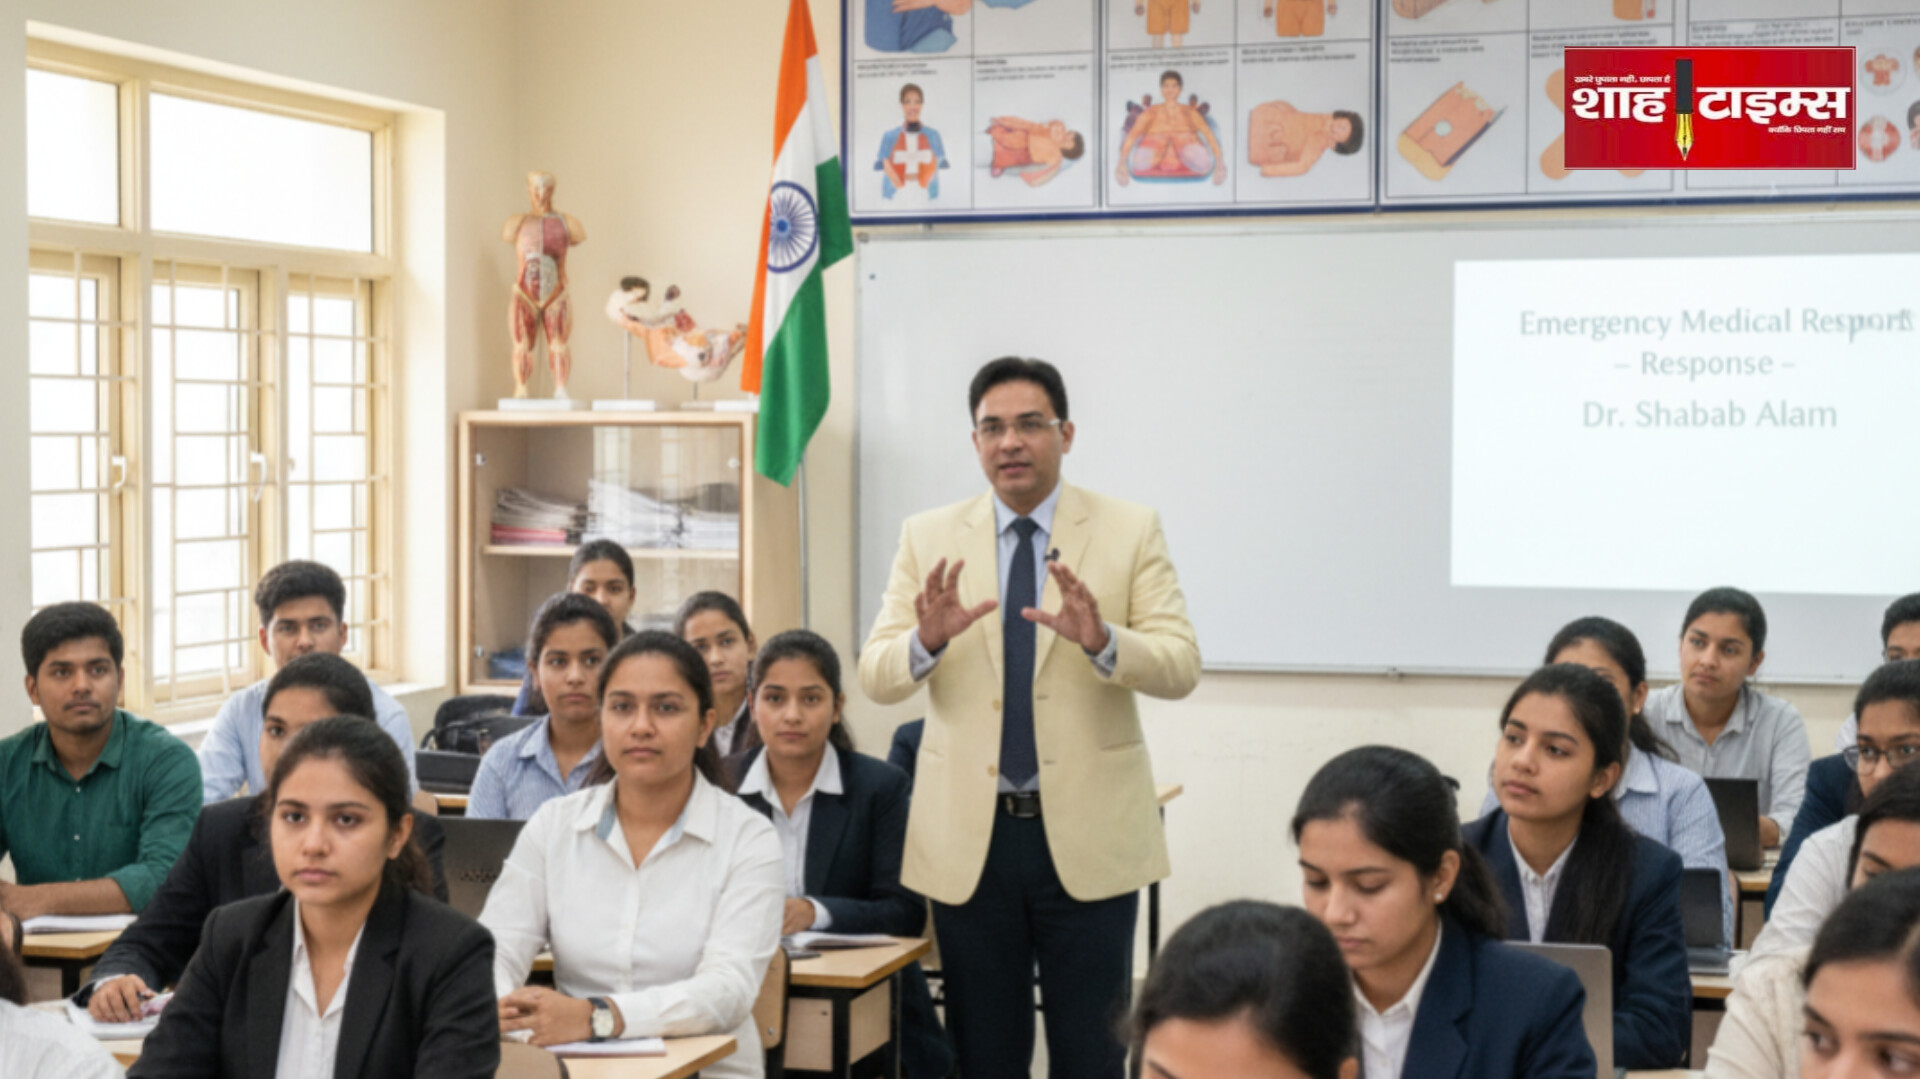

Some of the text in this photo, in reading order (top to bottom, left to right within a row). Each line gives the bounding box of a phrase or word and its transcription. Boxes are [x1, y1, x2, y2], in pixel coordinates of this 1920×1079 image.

[1521, 311, 1671, 340] Emergency
[1682, 308, 1790, 333] Medical
[1642, 352, 1773, 381] Response
[1584, 400, 1837, 427] Dr. Shabab Alam
